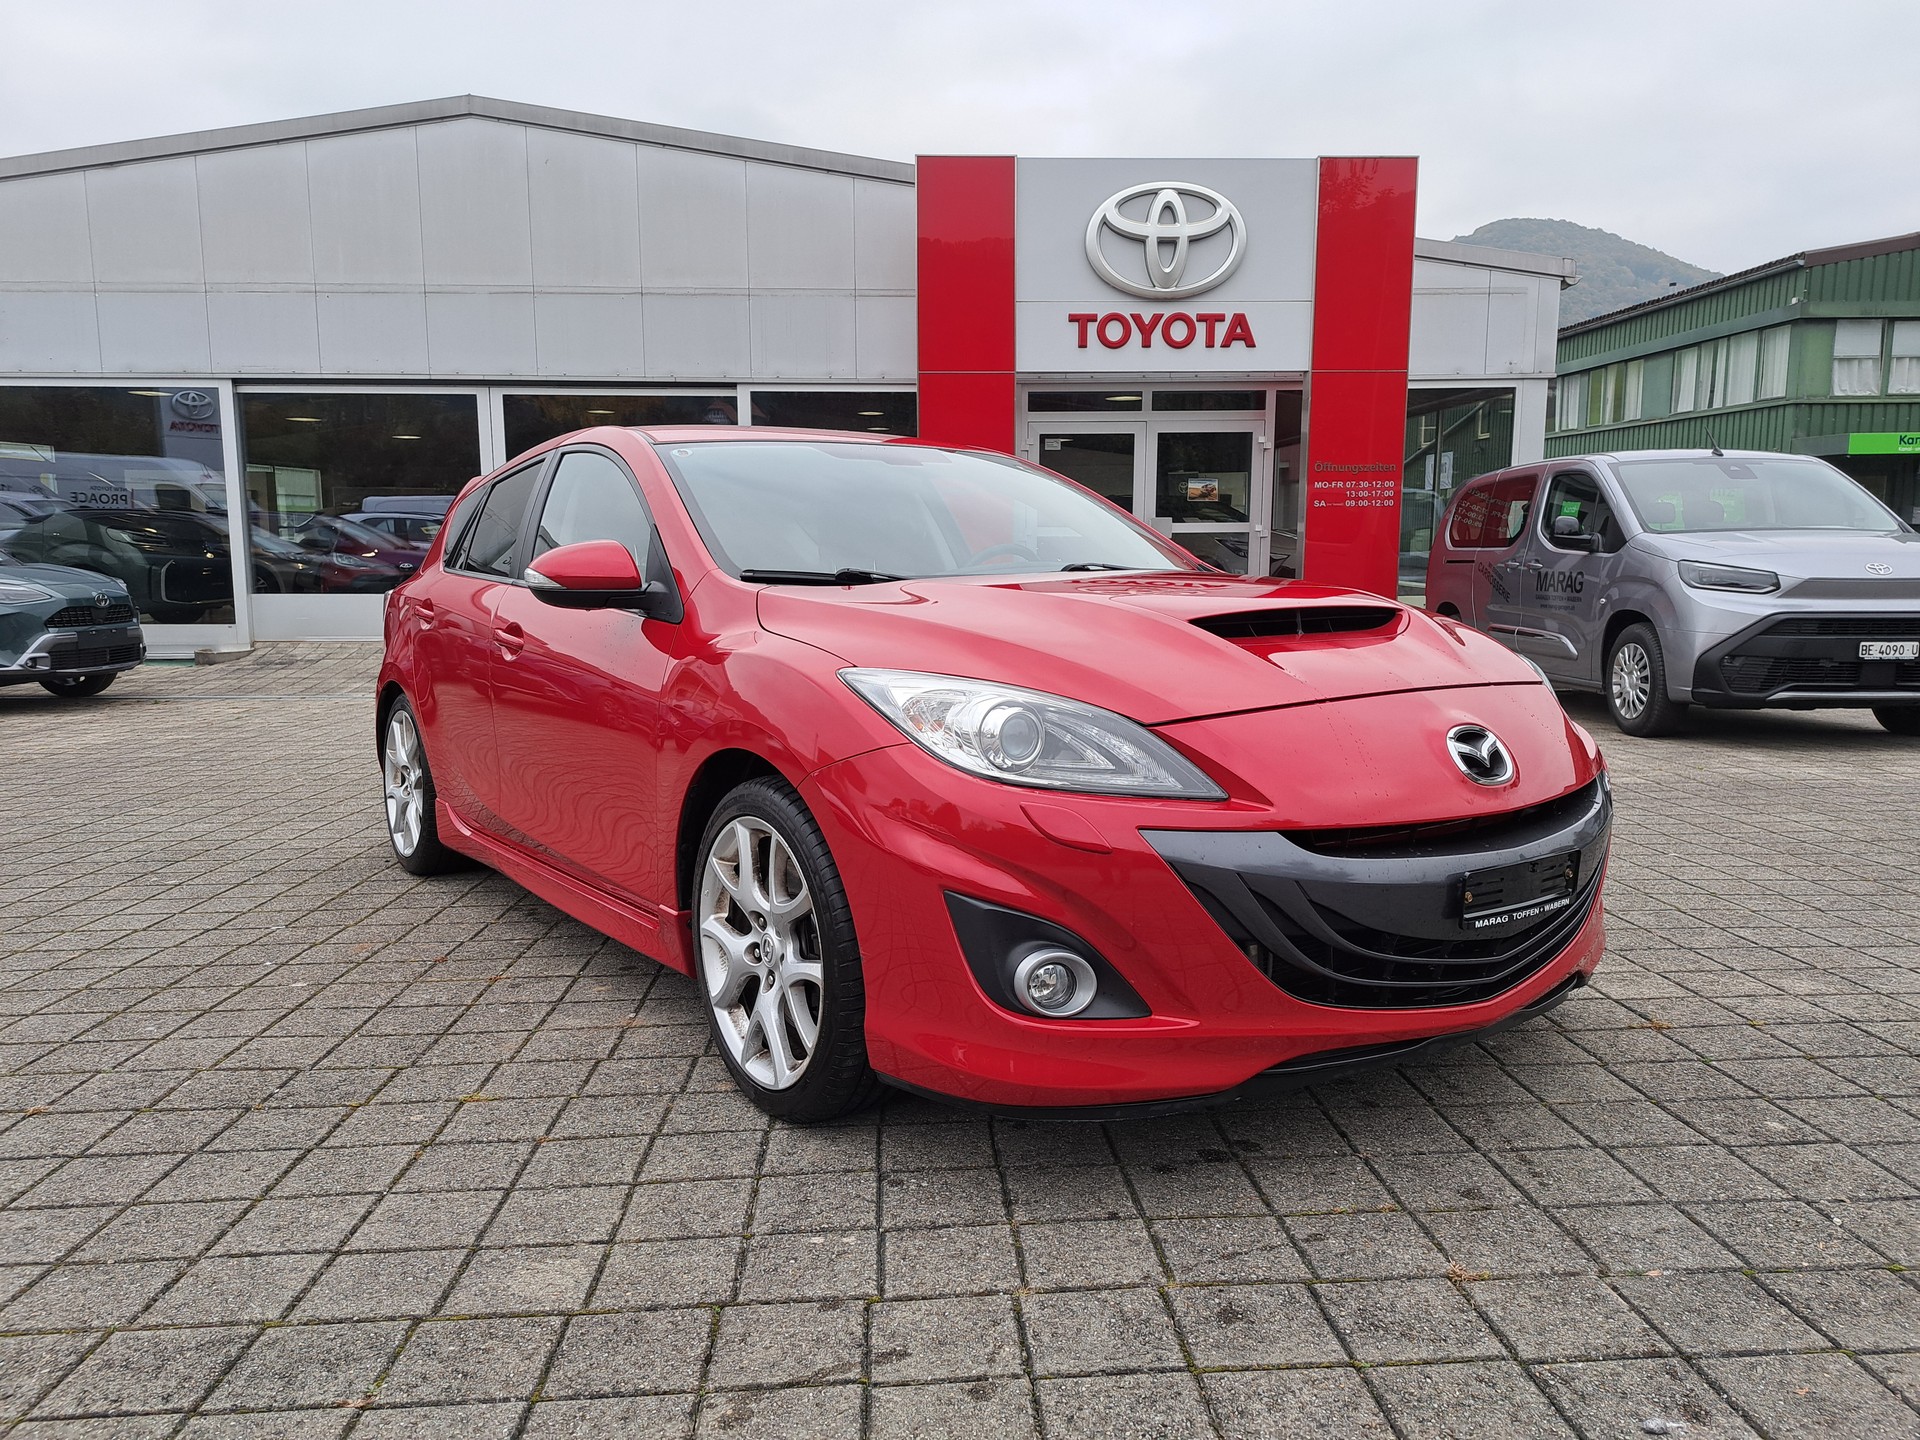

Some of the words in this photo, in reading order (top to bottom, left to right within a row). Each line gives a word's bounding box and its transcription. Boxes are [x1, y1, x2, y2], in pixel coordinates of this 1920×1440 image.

[1068, 312, 1256, 349] TOYOTA
[1314, 461, 1396, 475] Öffnungszeiten
[1314, 481, 1344, 489] MO-FR
[1345, 480, 1395, 488] 07:30-12:00
[1345, 499, 1394, 507] 09:00-12:00
[1535, 571, 1585, 593] MARAG
[1475, 915, 1509, 928] MARAG
[1512, 907, 1540, 920] TOFFEN
[1544, 898, 1570, 912] WABERN
